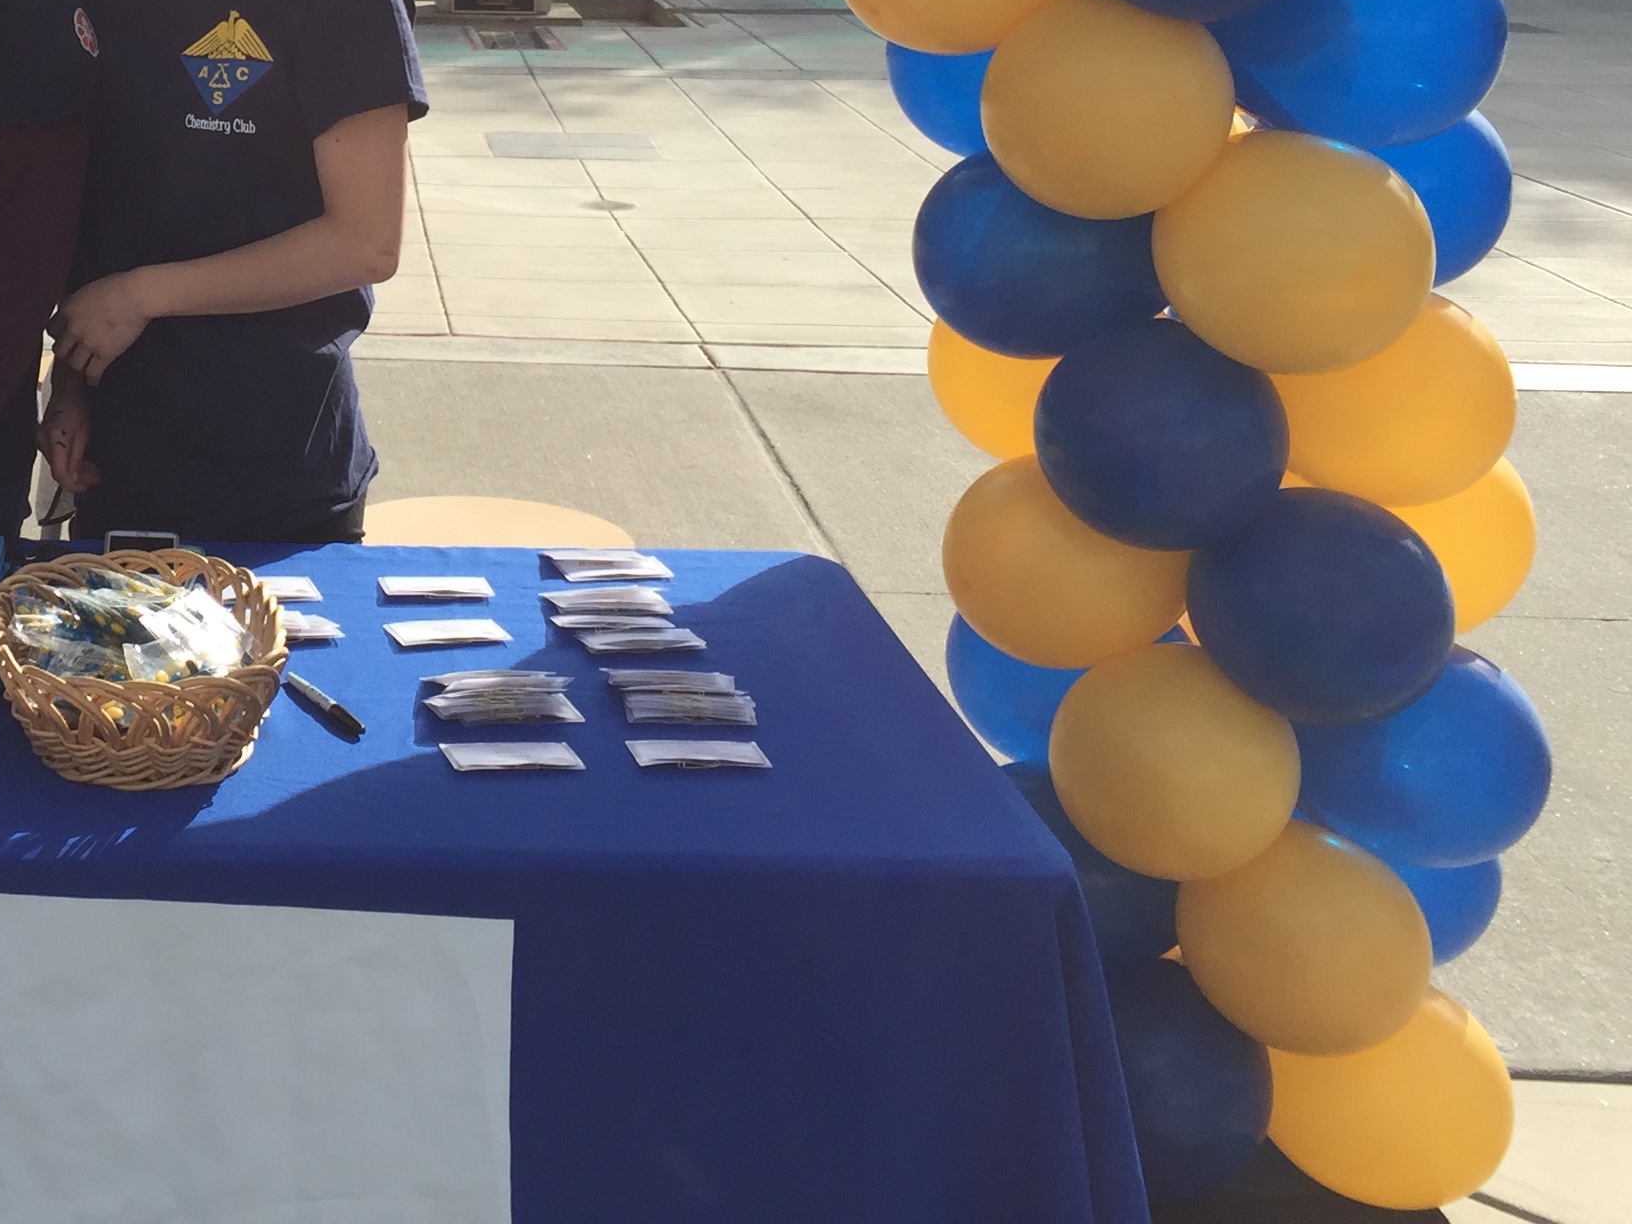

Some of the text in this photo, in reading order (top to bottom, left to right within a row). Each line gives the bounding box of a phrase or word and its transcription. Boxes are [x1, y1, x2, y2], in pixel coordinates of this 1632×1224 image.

[198, 66, 249, 81] A C
[212, 91, 224, 105] S
[185, 114, 256, 135] Chemistry Club
